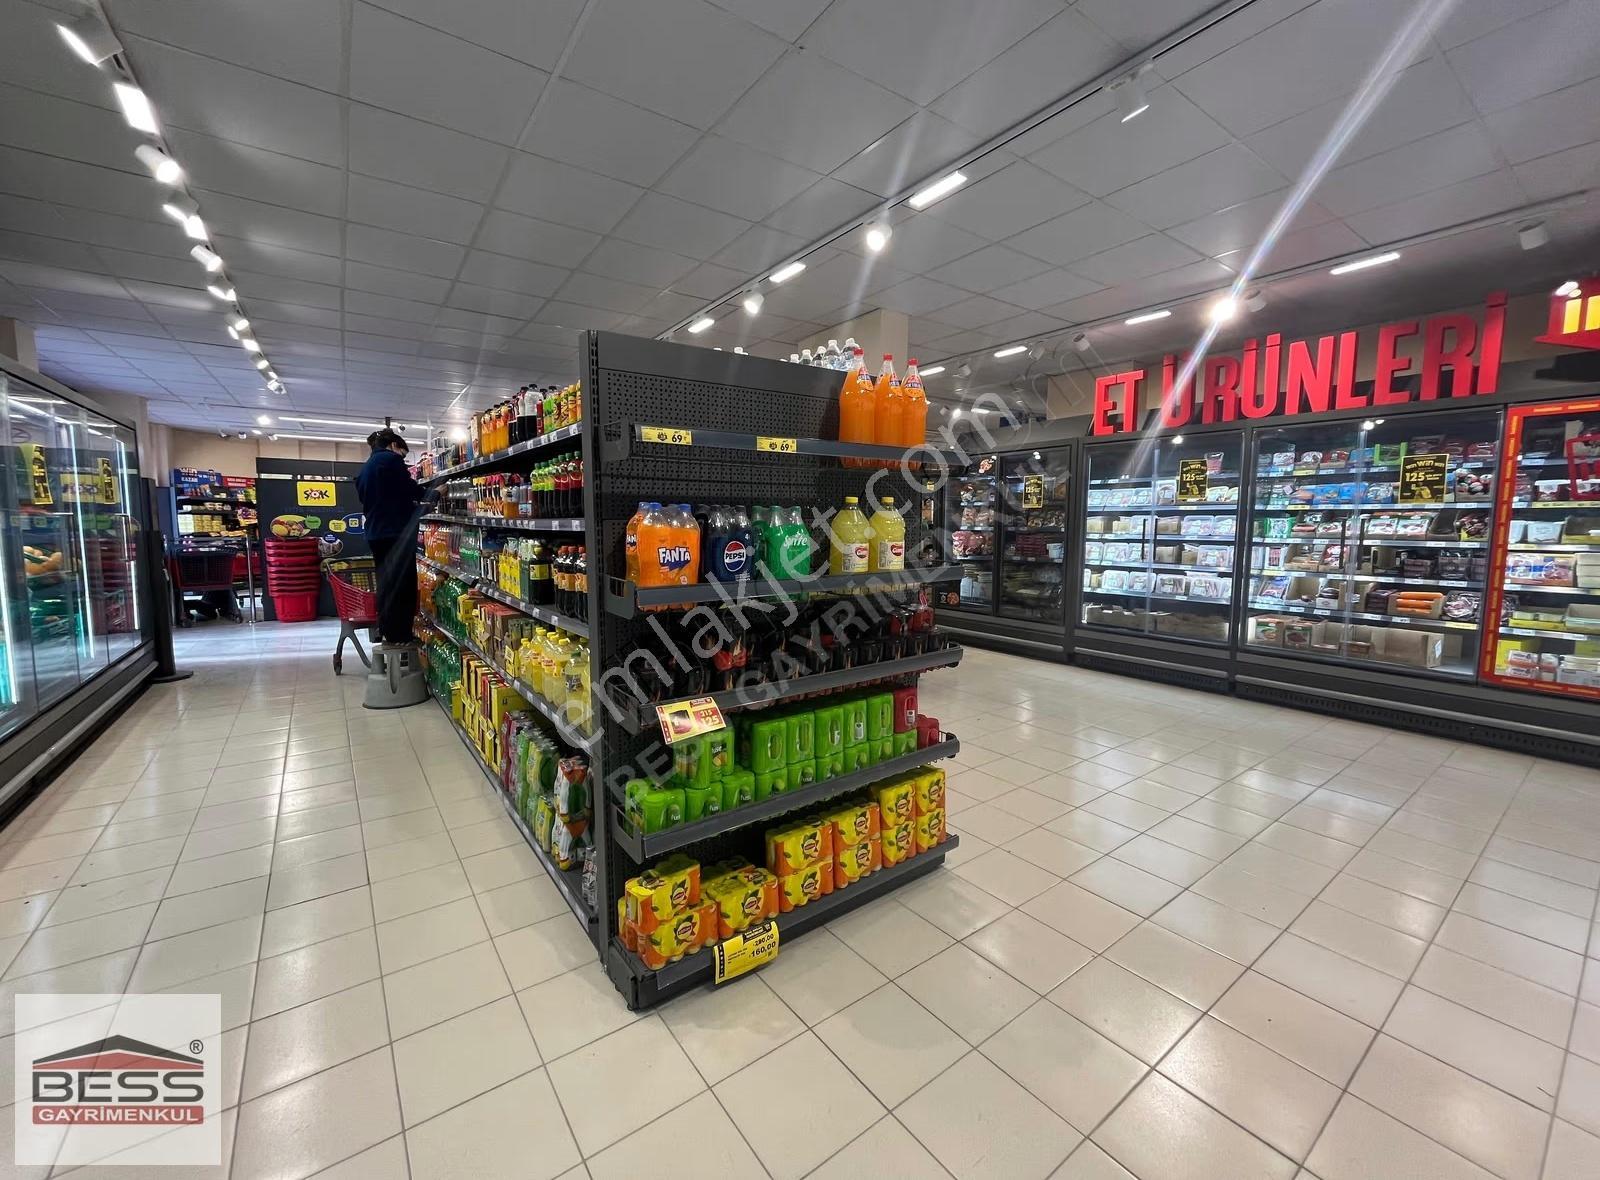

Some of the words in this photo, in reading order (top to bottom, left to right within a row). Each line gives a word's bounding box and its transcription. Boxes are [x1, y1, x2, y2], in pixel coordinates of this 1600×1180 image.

[1093, 369, 1145, 436] ET
[1161, 290, 1508, 428] ÜRÜNLERİ
[671, 434, 682, 443] 69
[780, 443, 790, 452] 69
[1405, 472, 1425, 482] 125
[783, 533, 808, 548] Sprite
[658, 546, 691, 563] FANTA
[725, 551, 745, 560] PEPSI
[751, 941, 776, 957] 160,00
